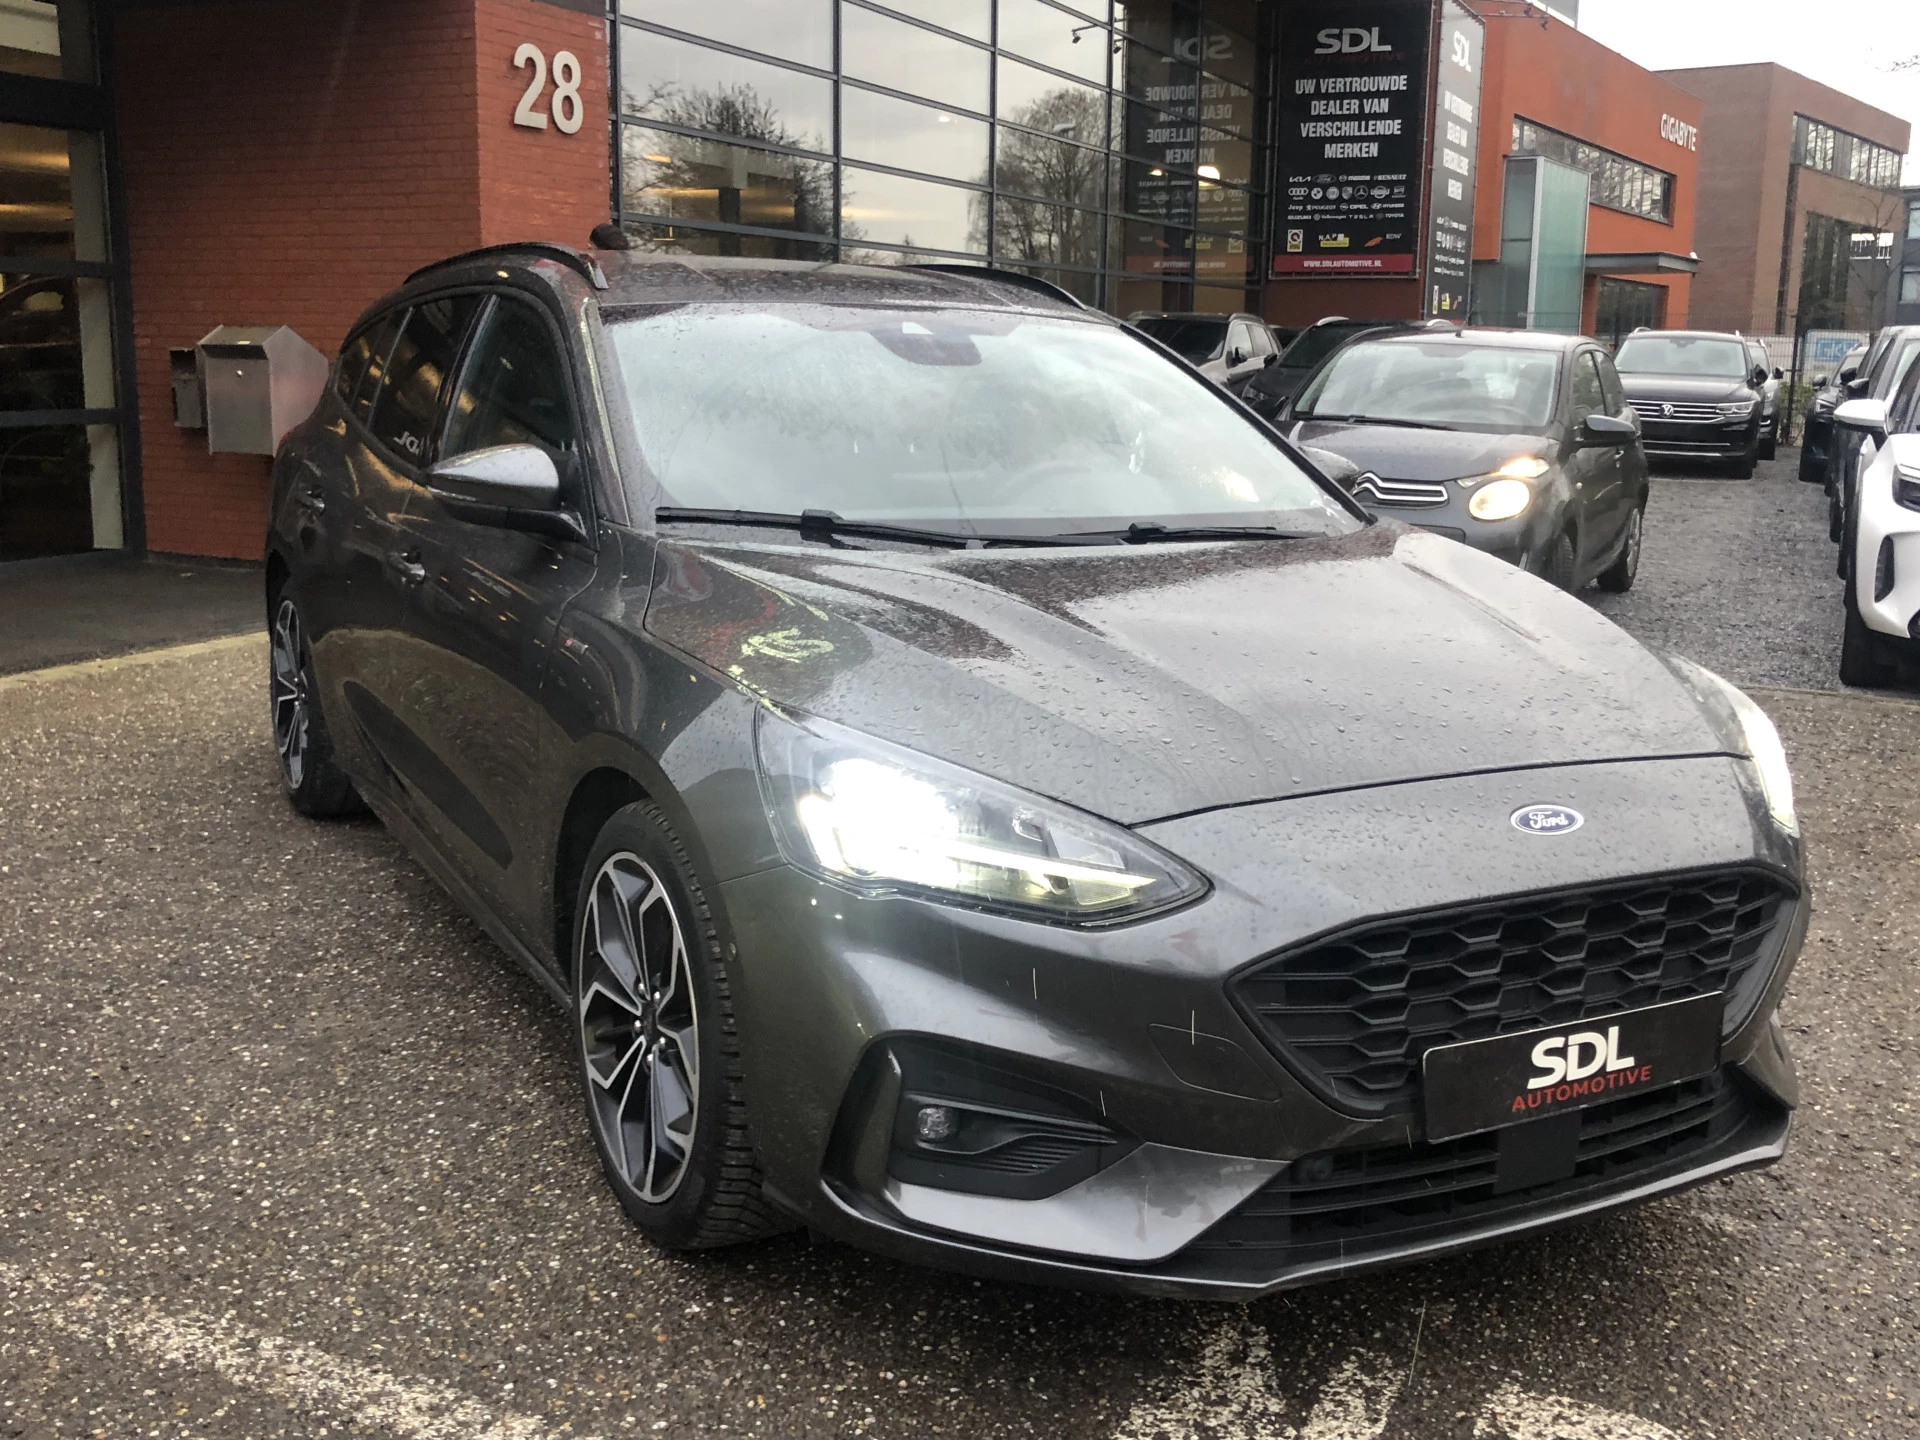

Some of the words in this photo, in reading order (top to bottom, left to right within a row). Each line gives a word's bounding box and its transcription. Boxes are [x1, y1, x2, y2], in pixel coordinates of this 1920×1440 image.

[1314, 26, 1392, 54] SDL
[512, 42, 584, 136] 28
[1295, 78, 1317, 95] UW
[1319, 74, 1408, 94] VERTROUWDE
[1310, 98, 1360, 116] DEALER
[1363, 97, 1389, 114] VAN
[1300, 119, 1402, 138] VERSCHILLENDE
[1660, 113, 1697, 152] GIGABYTE
[1324, 142, 1379, 159] MERKEN
[1377, 173, 1408, 181] RENAULT
[1526, 1025, 1636, 1090] SDL
[1511, 1064, 1653, 1113] AUTOMOTIVE
